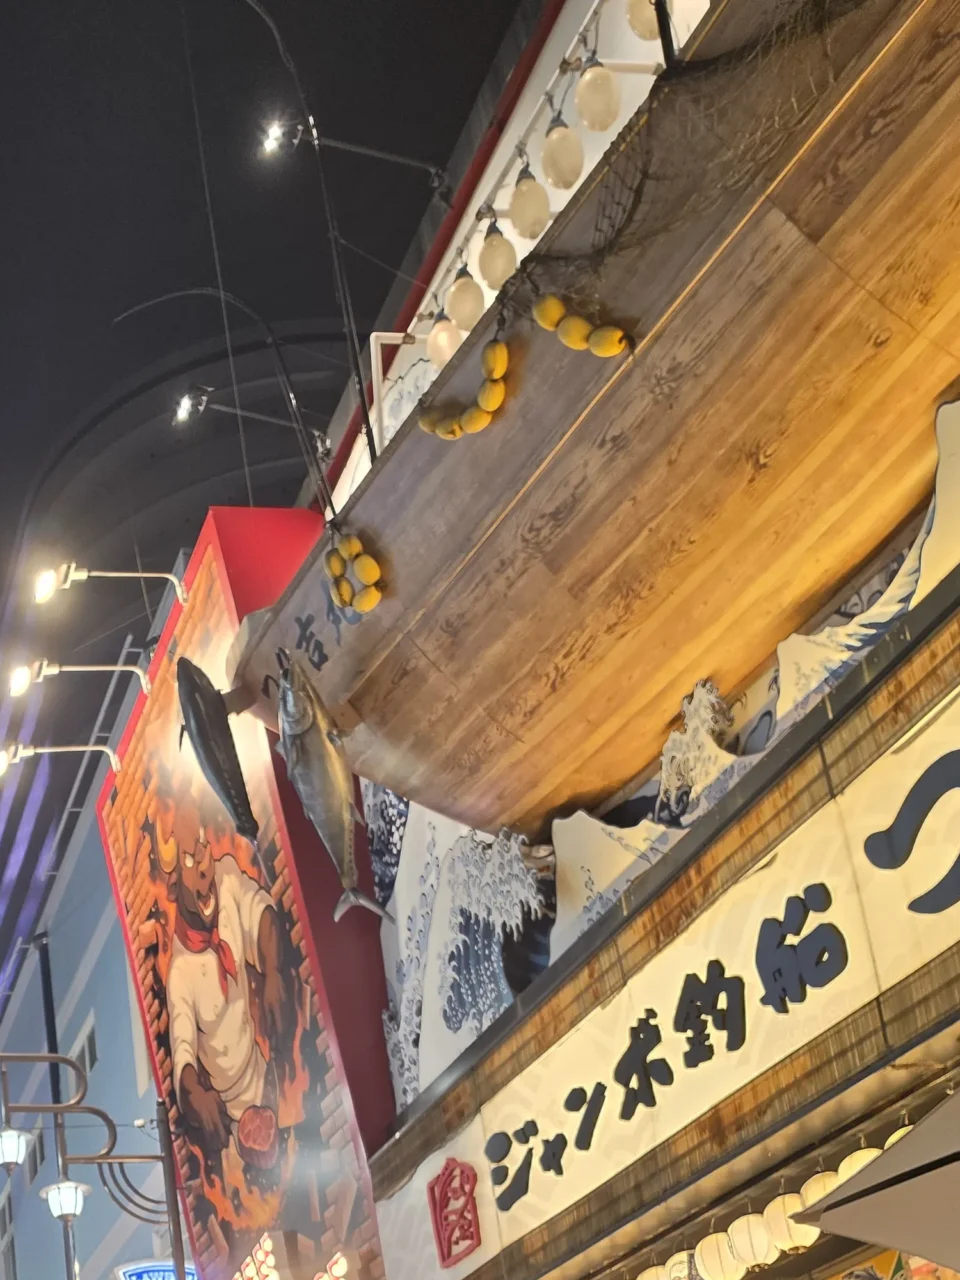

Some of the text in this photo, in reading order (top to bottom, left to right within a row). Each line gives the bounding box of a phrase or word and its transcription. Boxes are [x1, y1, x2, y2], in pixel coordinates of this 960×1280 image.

[484, 882, 849, 1211] ジャンボ釣船
